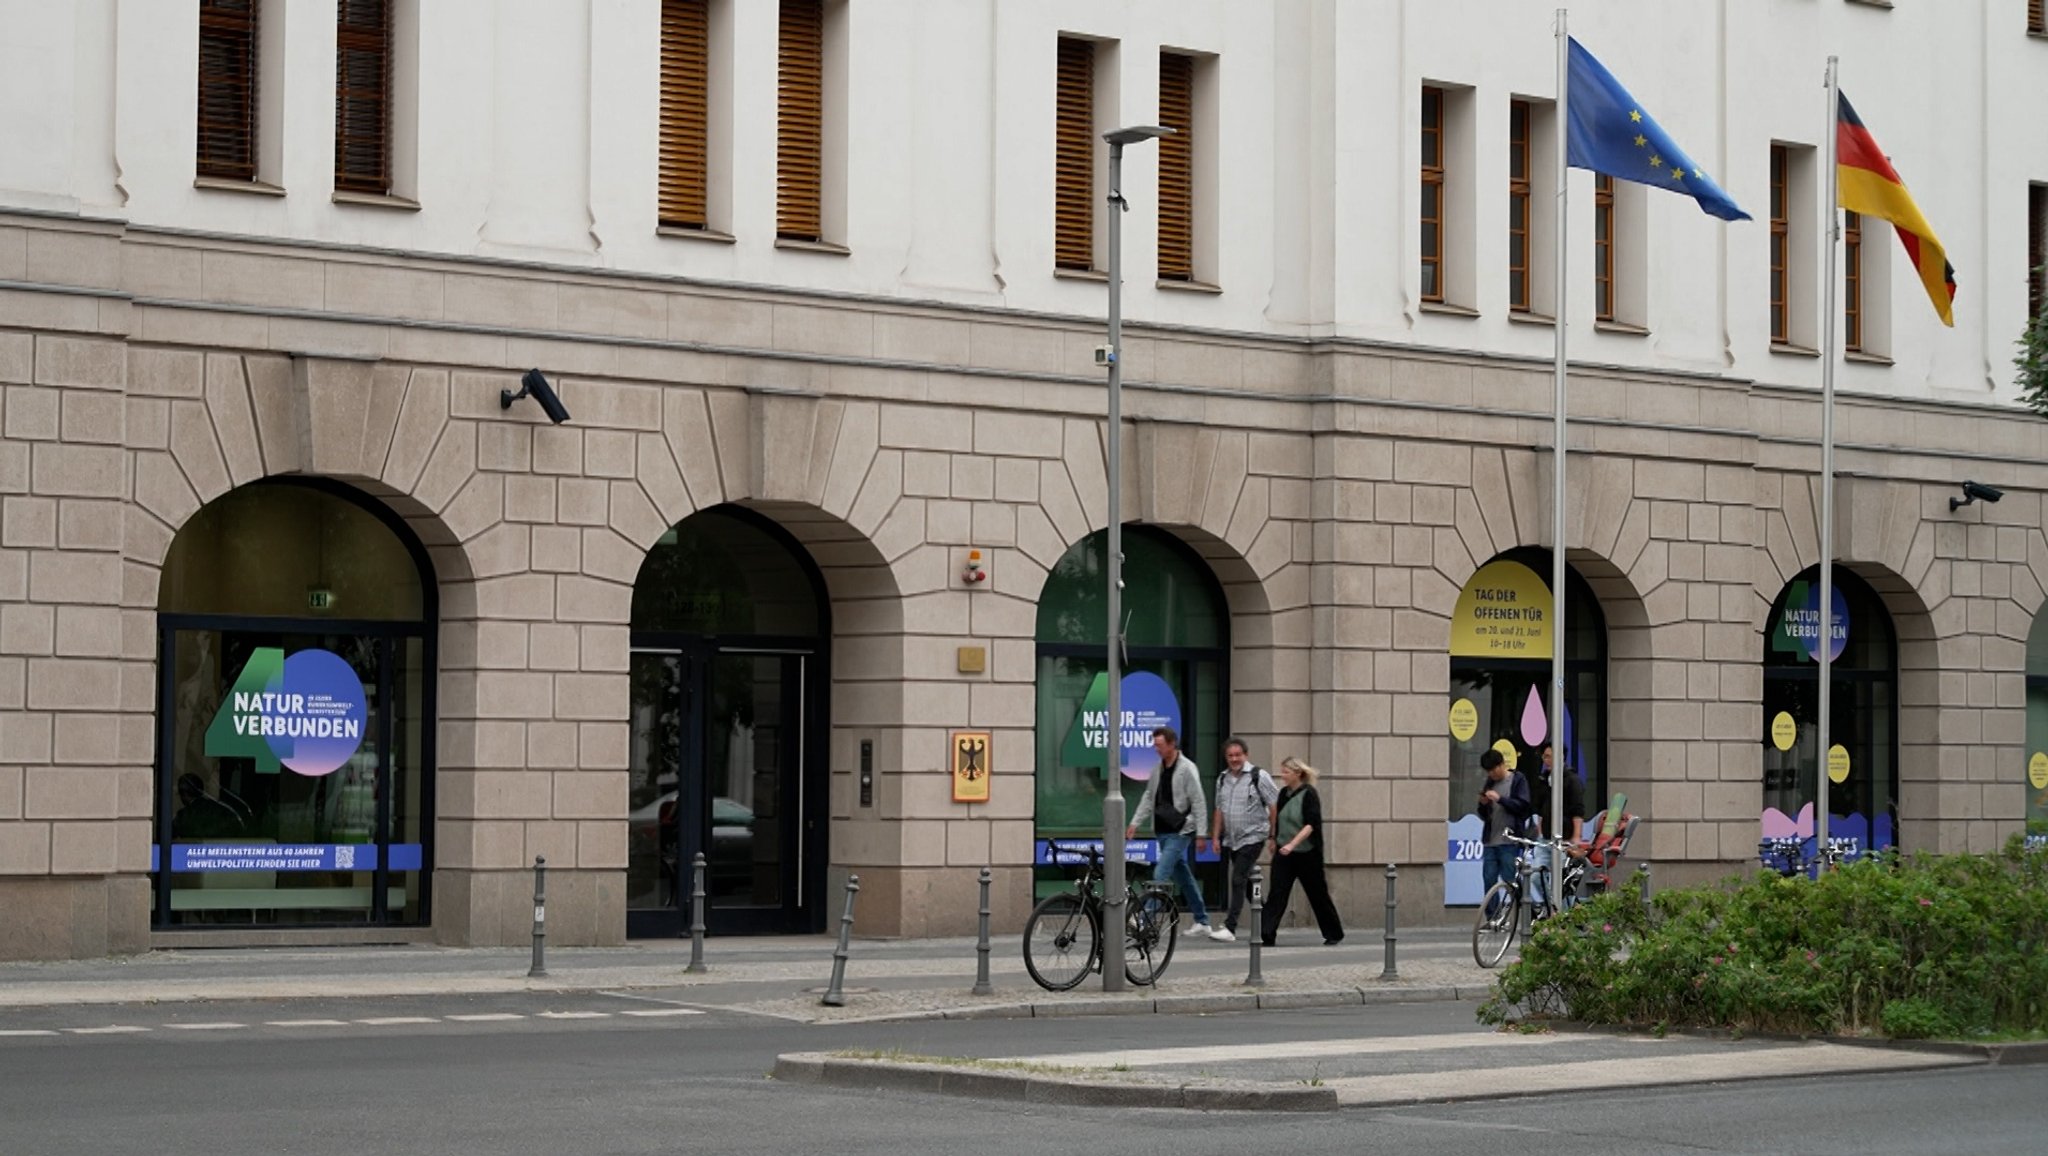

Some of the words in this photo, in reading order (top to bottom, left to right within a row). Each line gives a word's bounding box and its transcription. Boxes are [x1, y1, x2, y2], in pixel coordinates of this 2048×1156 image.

[1474, 589, 1494, 601] TAG
[1496, 591, 1516, 602] DER
[1474, 606, 1520, 620] OFFENEN
[1523, 606, 1543, 621] TÜR
[1785, 609, 1820, 623] NATUR
[1475, 627, 1487, 635] am
[1488, 625, 1499, 635] 20.
[1500, 626, 1514, 635] und
[1527, 627, 1541, 636] Juni
[1785, 624, 1846, 639] VERBUEN
[1513, 640, 1526, 649] Uhr
[234, 692, 304, 714] NATUR
[233, 715, 359, 738] VERBUNDEN
[1456, 840, 1484, 860] 200
[187, 859, 255, 868] UMWELTPOLITIK
[255, 859, 286, 868] FINDEN
[287, 859, 300, 868] SIE
[301, 859, 321, 868] HIER
